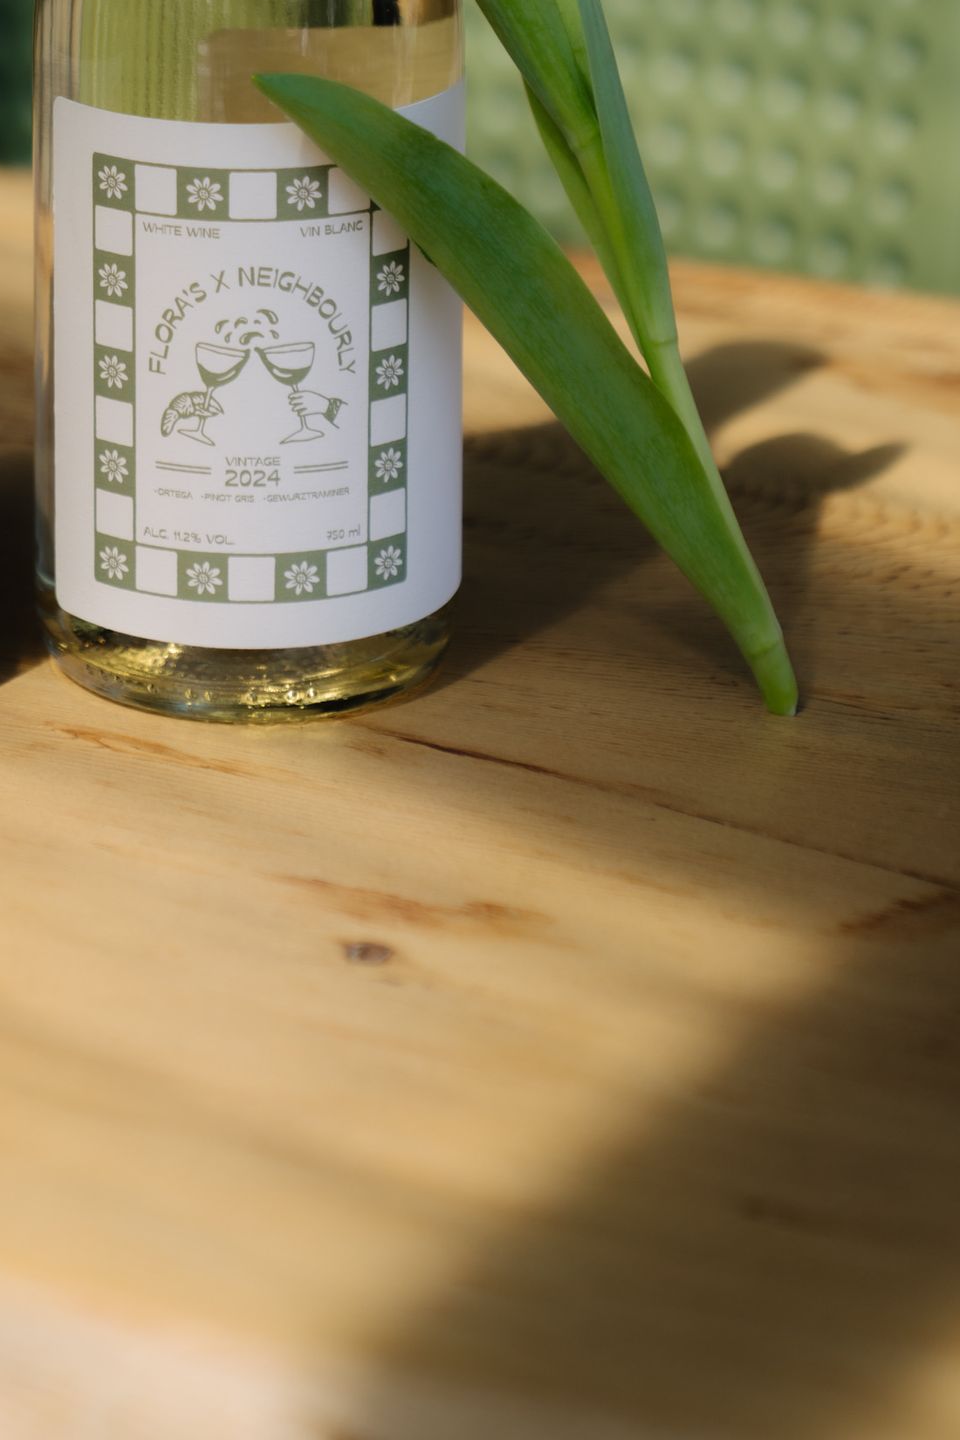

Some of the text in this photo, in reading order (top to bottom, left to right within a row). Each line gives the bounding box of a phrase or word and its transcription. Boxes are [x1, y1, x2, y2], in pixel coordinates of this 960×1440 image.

[143, 221, 221, 239] WHITE WINE
[300, 220, 364, 238] VIN BLANC
[149, 266, 356, 375] FLORA'S X NEIGHBOURLY
[225, 456, 281, 467] VINTAGE
[225, 469, 281, 487] 2024
[204, 493, 232, 503] PINOT
[173, 530, 201, 544] 11.2%
[327, 524, 360, 541] 750 ml
